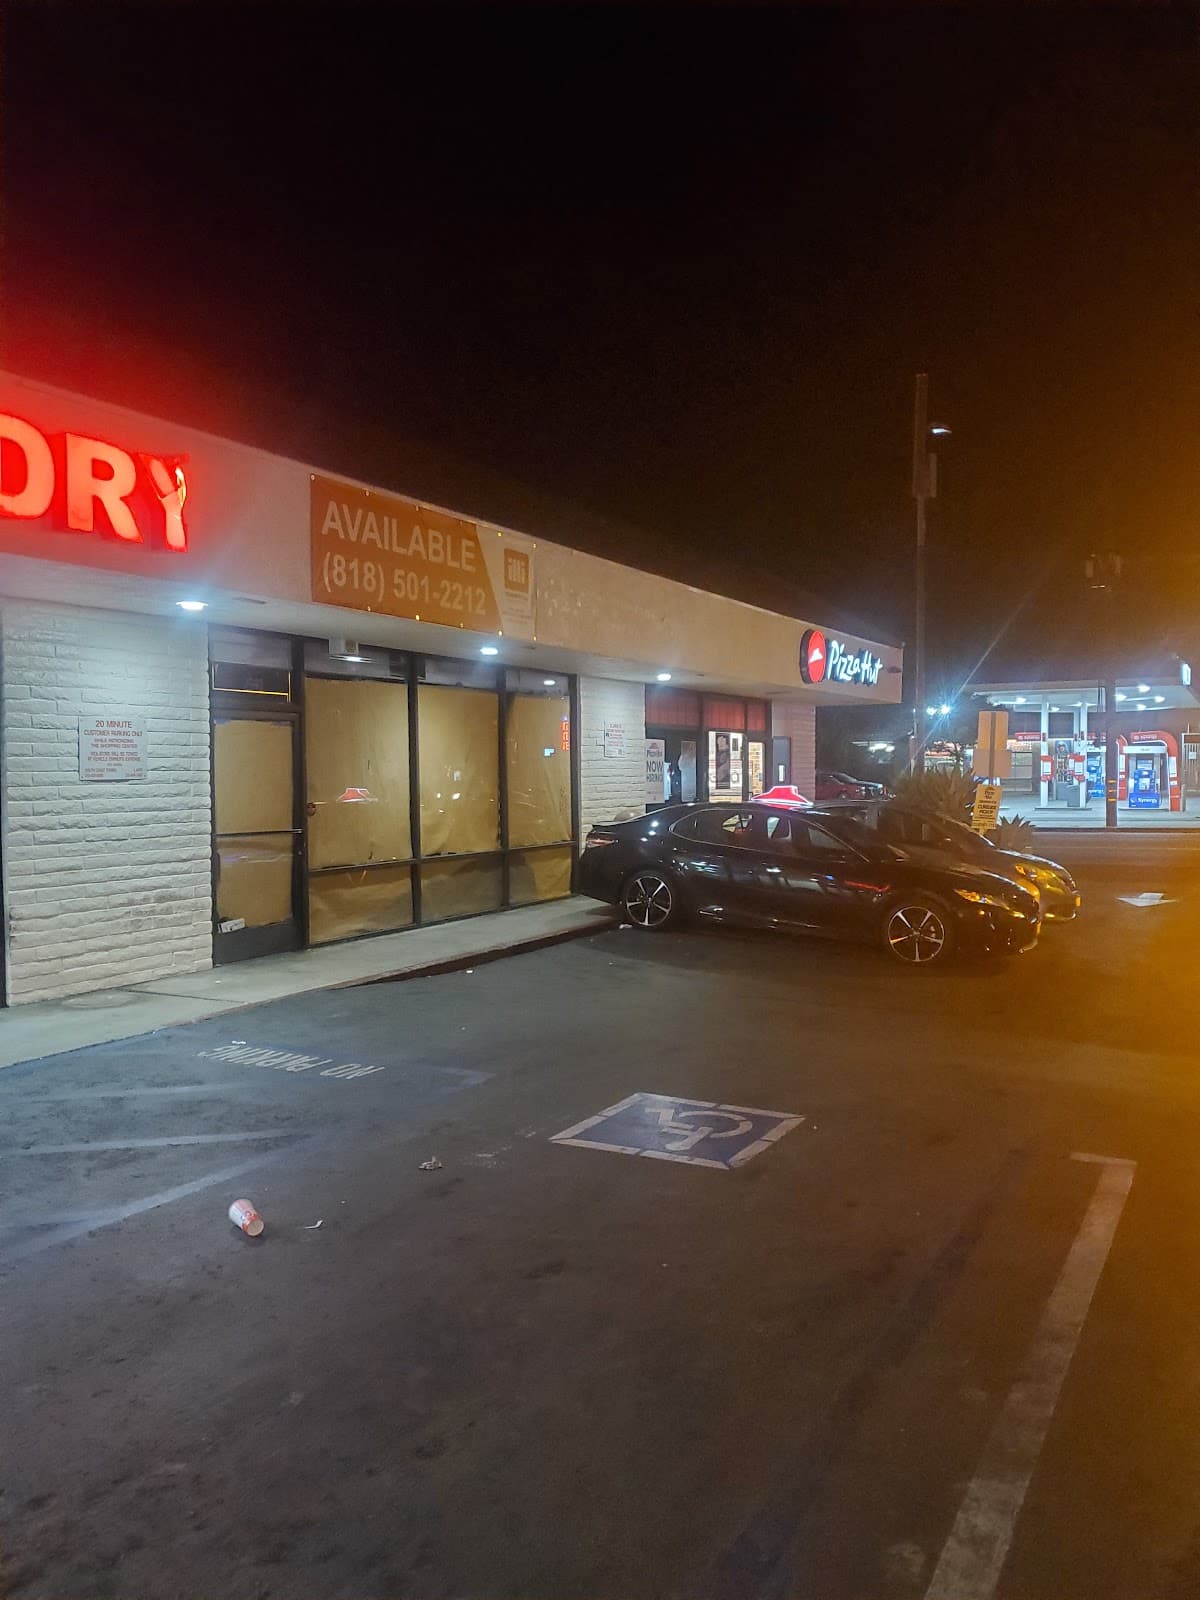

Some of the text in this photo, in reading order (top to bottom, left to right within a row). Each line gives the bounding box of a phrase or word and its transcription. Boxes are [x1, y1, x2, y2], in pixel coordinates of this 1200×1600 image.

[321, 500, 477, 573] AVAILABLE
[322, 551, 487, 616] (818) 501-2212
[827, 639, 884, 685] Pizza Hut
[95, 720, 133, 729] 20 MINUTE
[646, 760, 664, 773] NOW
